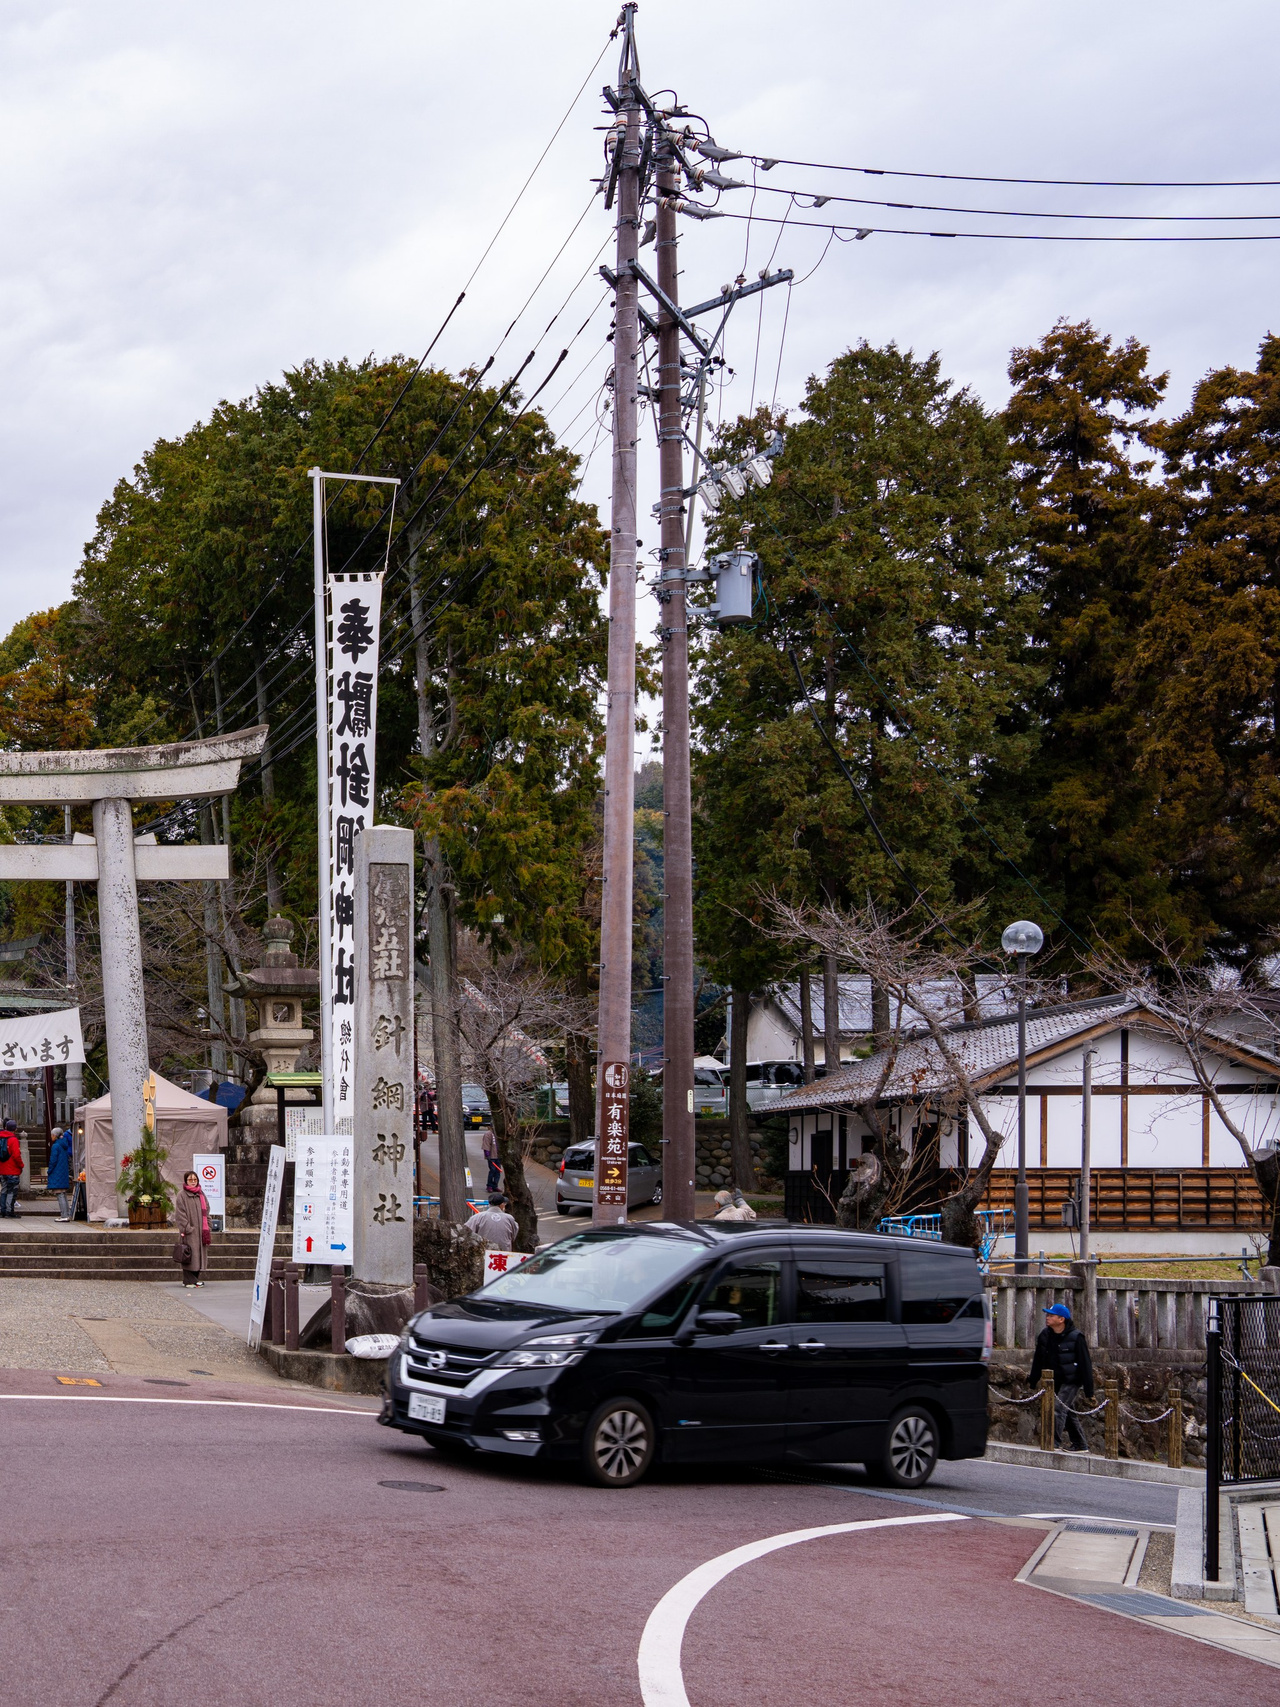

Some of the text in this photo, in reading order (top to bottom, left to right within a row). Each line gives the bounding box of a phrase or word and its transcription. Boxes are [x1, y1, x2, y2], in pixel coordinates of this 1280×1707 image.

[371, 1014, 407, 1225] 針綱神社
[606, 1103, 623, 1154] 有楽苑
